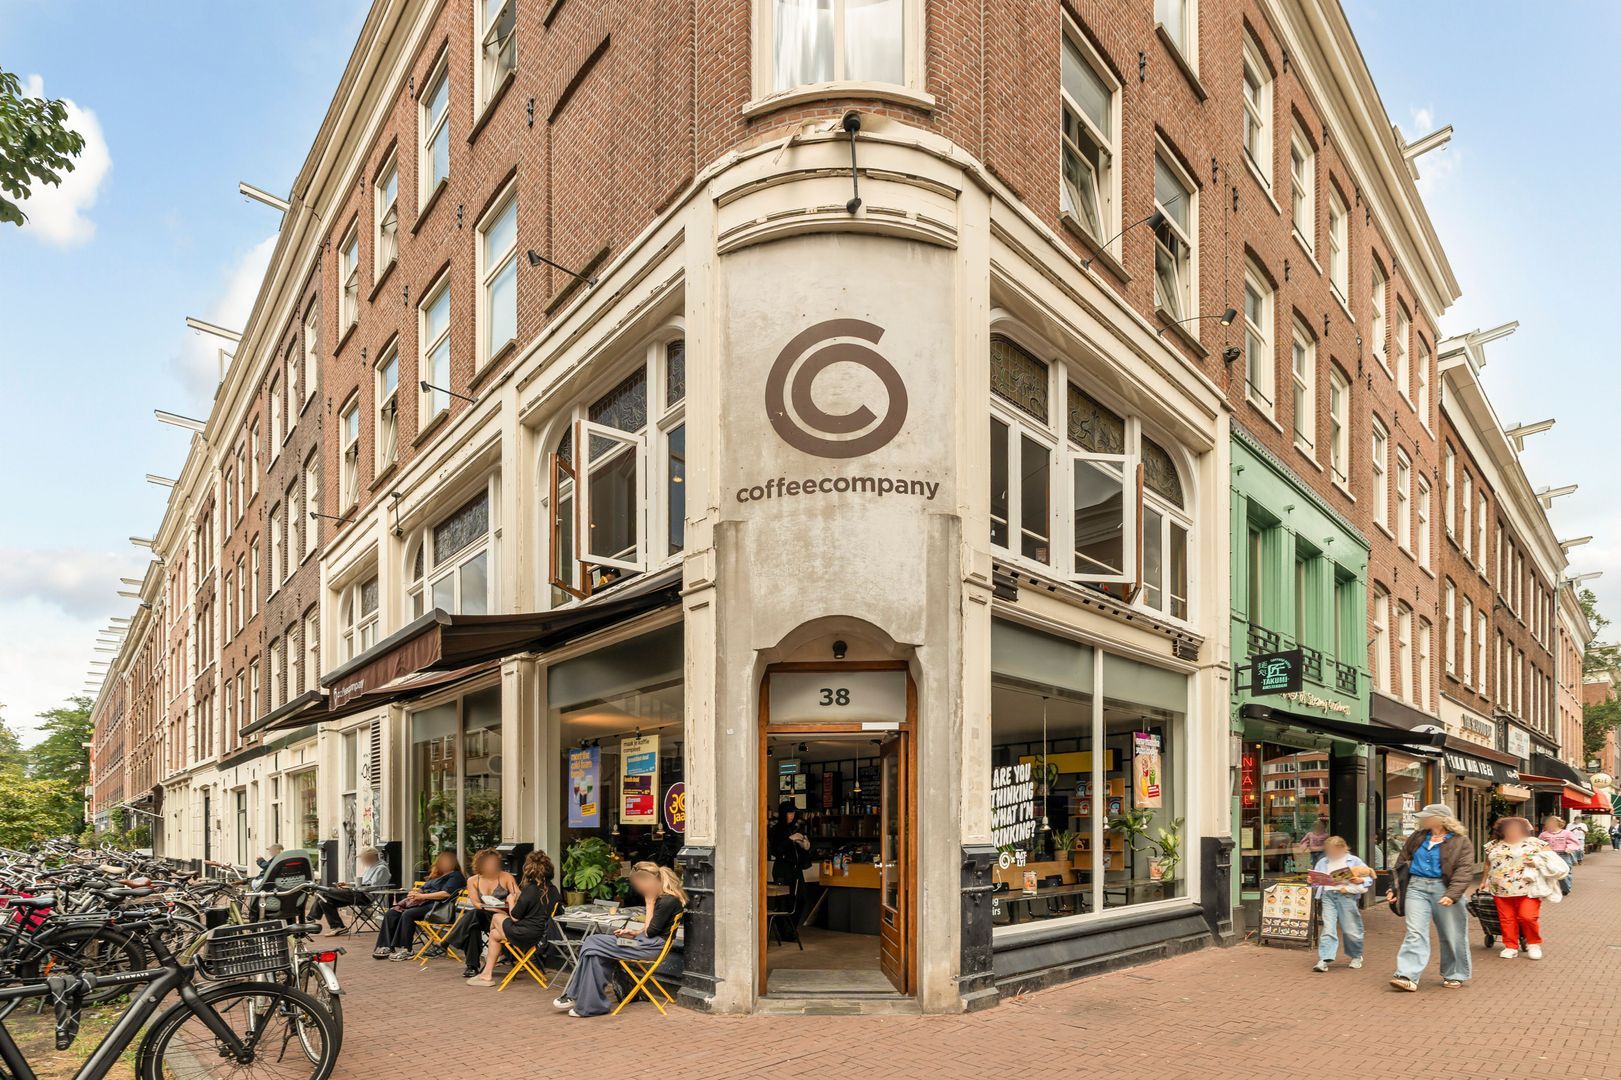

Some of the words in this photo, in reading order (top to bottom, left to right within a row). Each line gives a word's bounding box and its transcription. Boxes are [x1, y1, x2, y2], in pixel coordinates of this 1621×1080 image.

[736, 476, 940, 503] coffeecompany
[1262, 676, 1288, 686] TAKUMI
[819, 688, 851, 706] 38
[993, 766, 1012, 788] ARE
[1013, 763, 1031, 784] YOU
[991, 782, 1033, 808] THINKING
[673, 812, 686, 824] jaa
[991, 804, 1018, 829] WHAT
[1020, 801, 1033, 821] I'M
